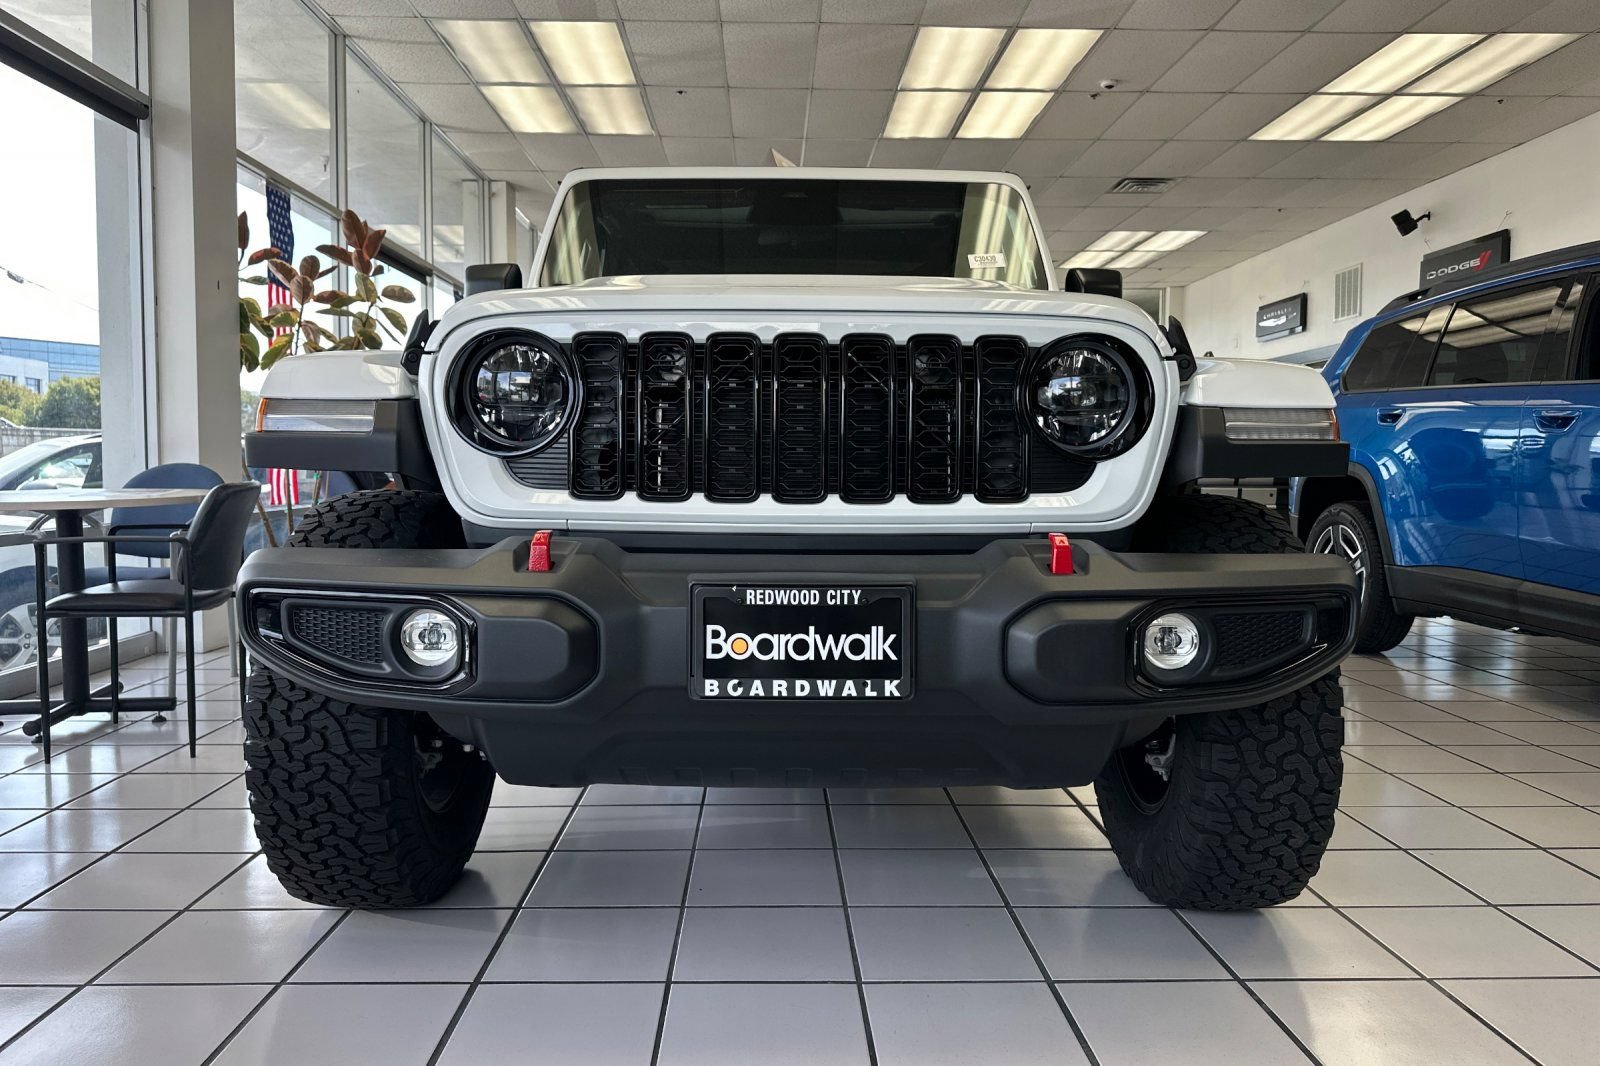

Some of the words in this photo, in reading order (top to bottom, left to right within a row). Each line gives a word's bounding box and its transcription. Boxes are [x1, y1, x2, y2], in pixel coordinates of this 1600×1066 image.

[1426, 257, 1481, 280] DODGE
[746, 589, 820, 605] REDWOOD
[826, 589, 862, 605] CITY
[705, 624, 898, 661] Boardwalk
[704, 679, 901, 697] BOARDWALK
